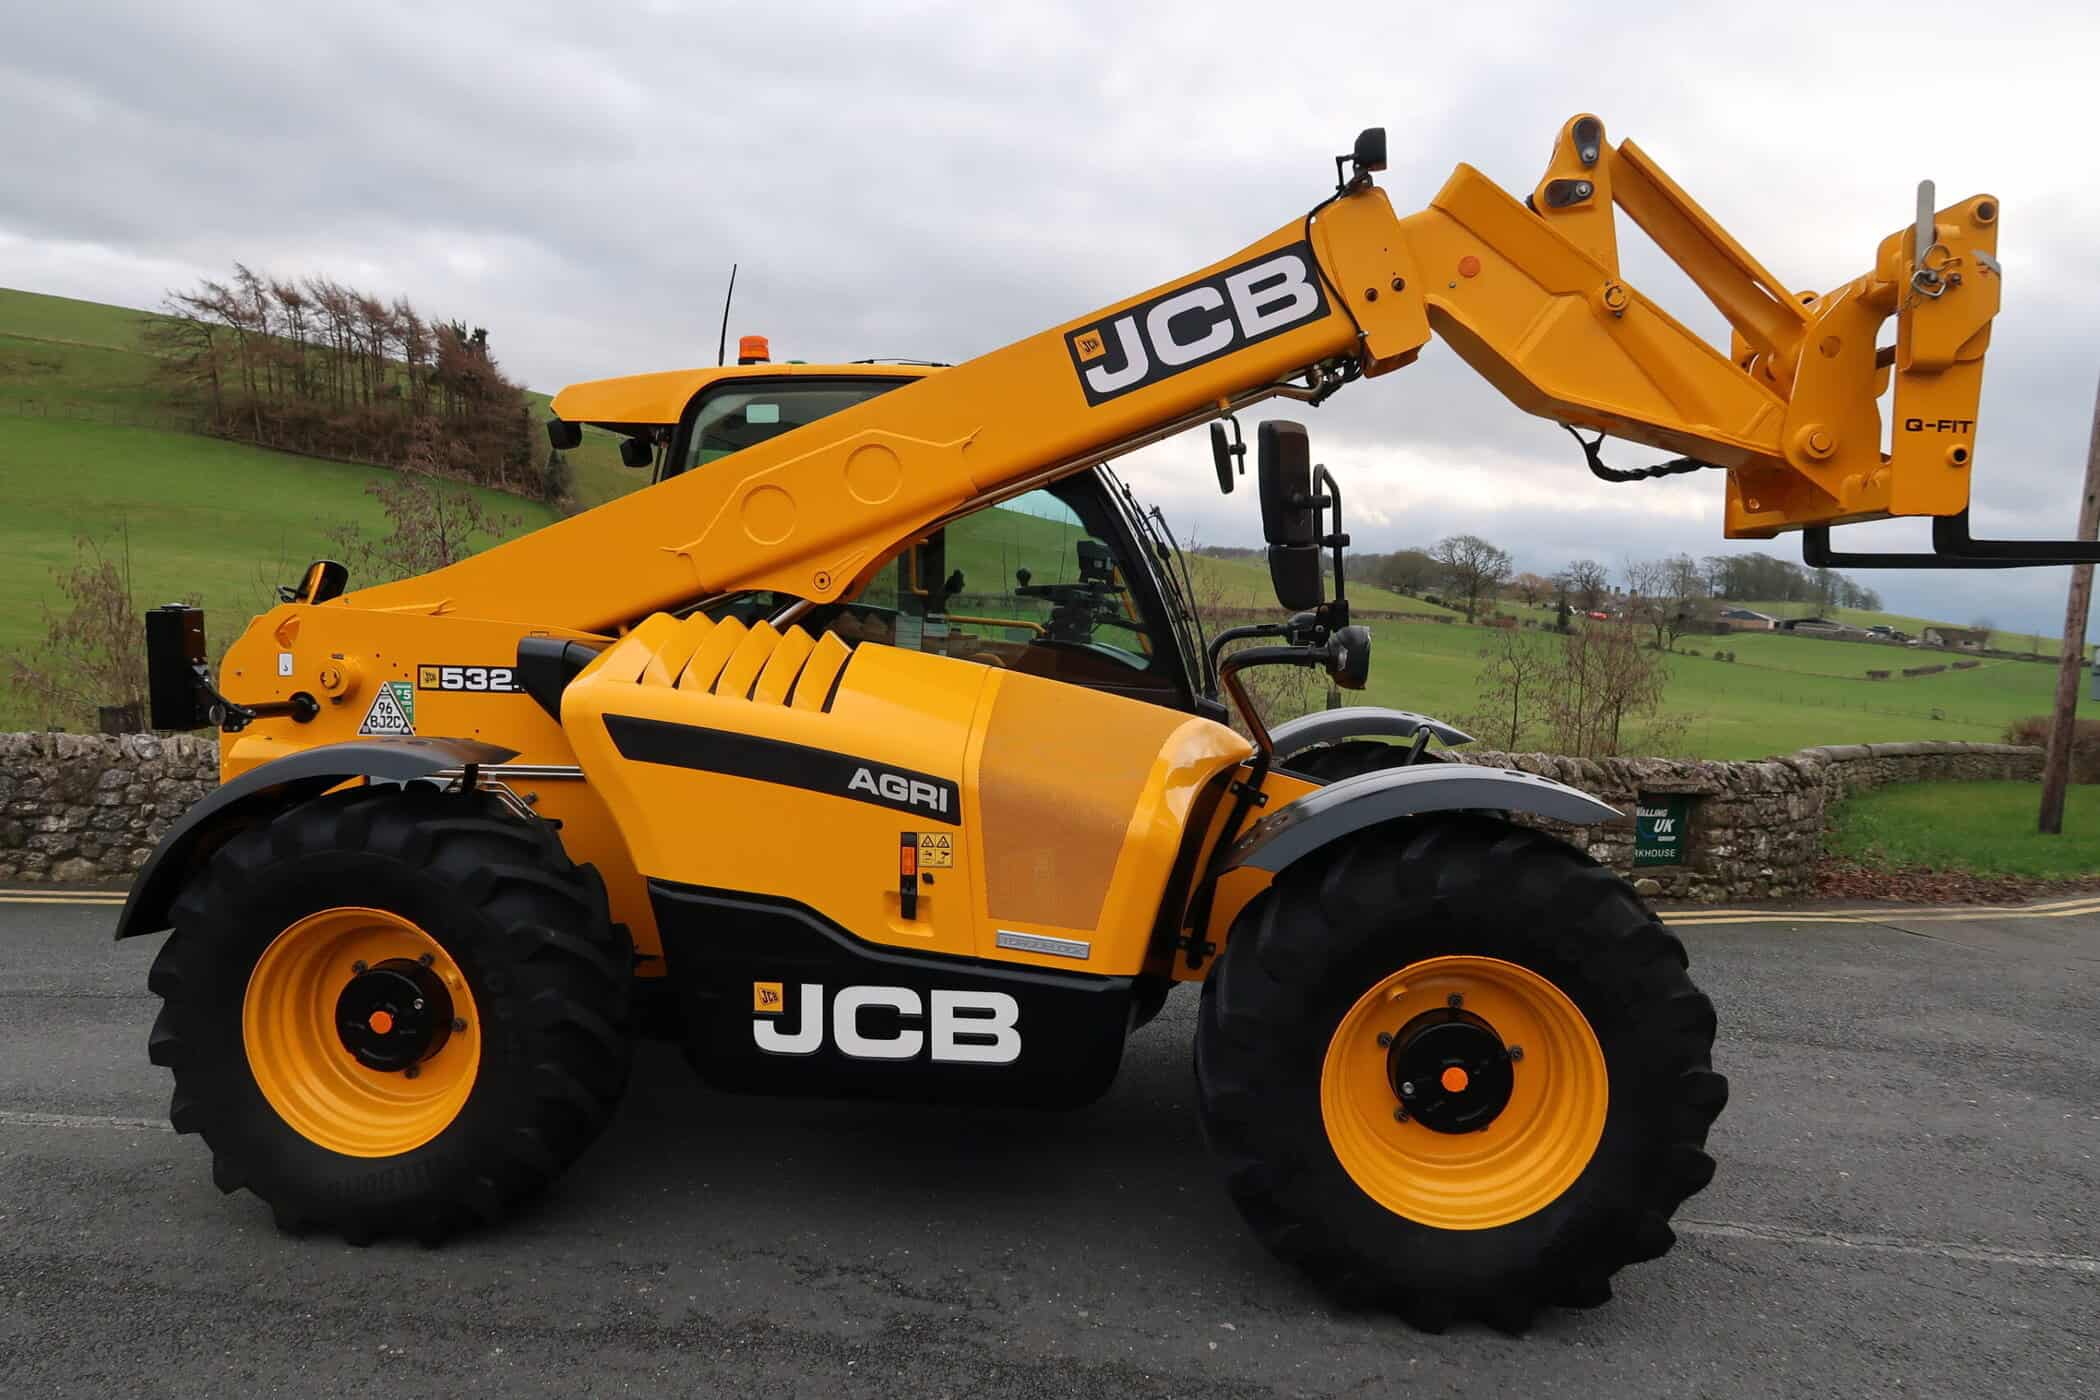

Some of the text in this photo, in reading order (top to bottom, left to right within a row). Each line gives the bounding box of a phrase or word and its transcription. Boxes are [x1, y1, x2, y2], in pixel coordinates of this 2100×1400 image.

[1086, 255, 1319, 393] JCB
[1905, 418, 1974, 434] Q-FIT
[378, 701, 393, 715] 96
[847, 767, 948, 813] AGRI
[1653, 819, 1676, 833] UK
[753, 984, 1022, 1064] JCB
